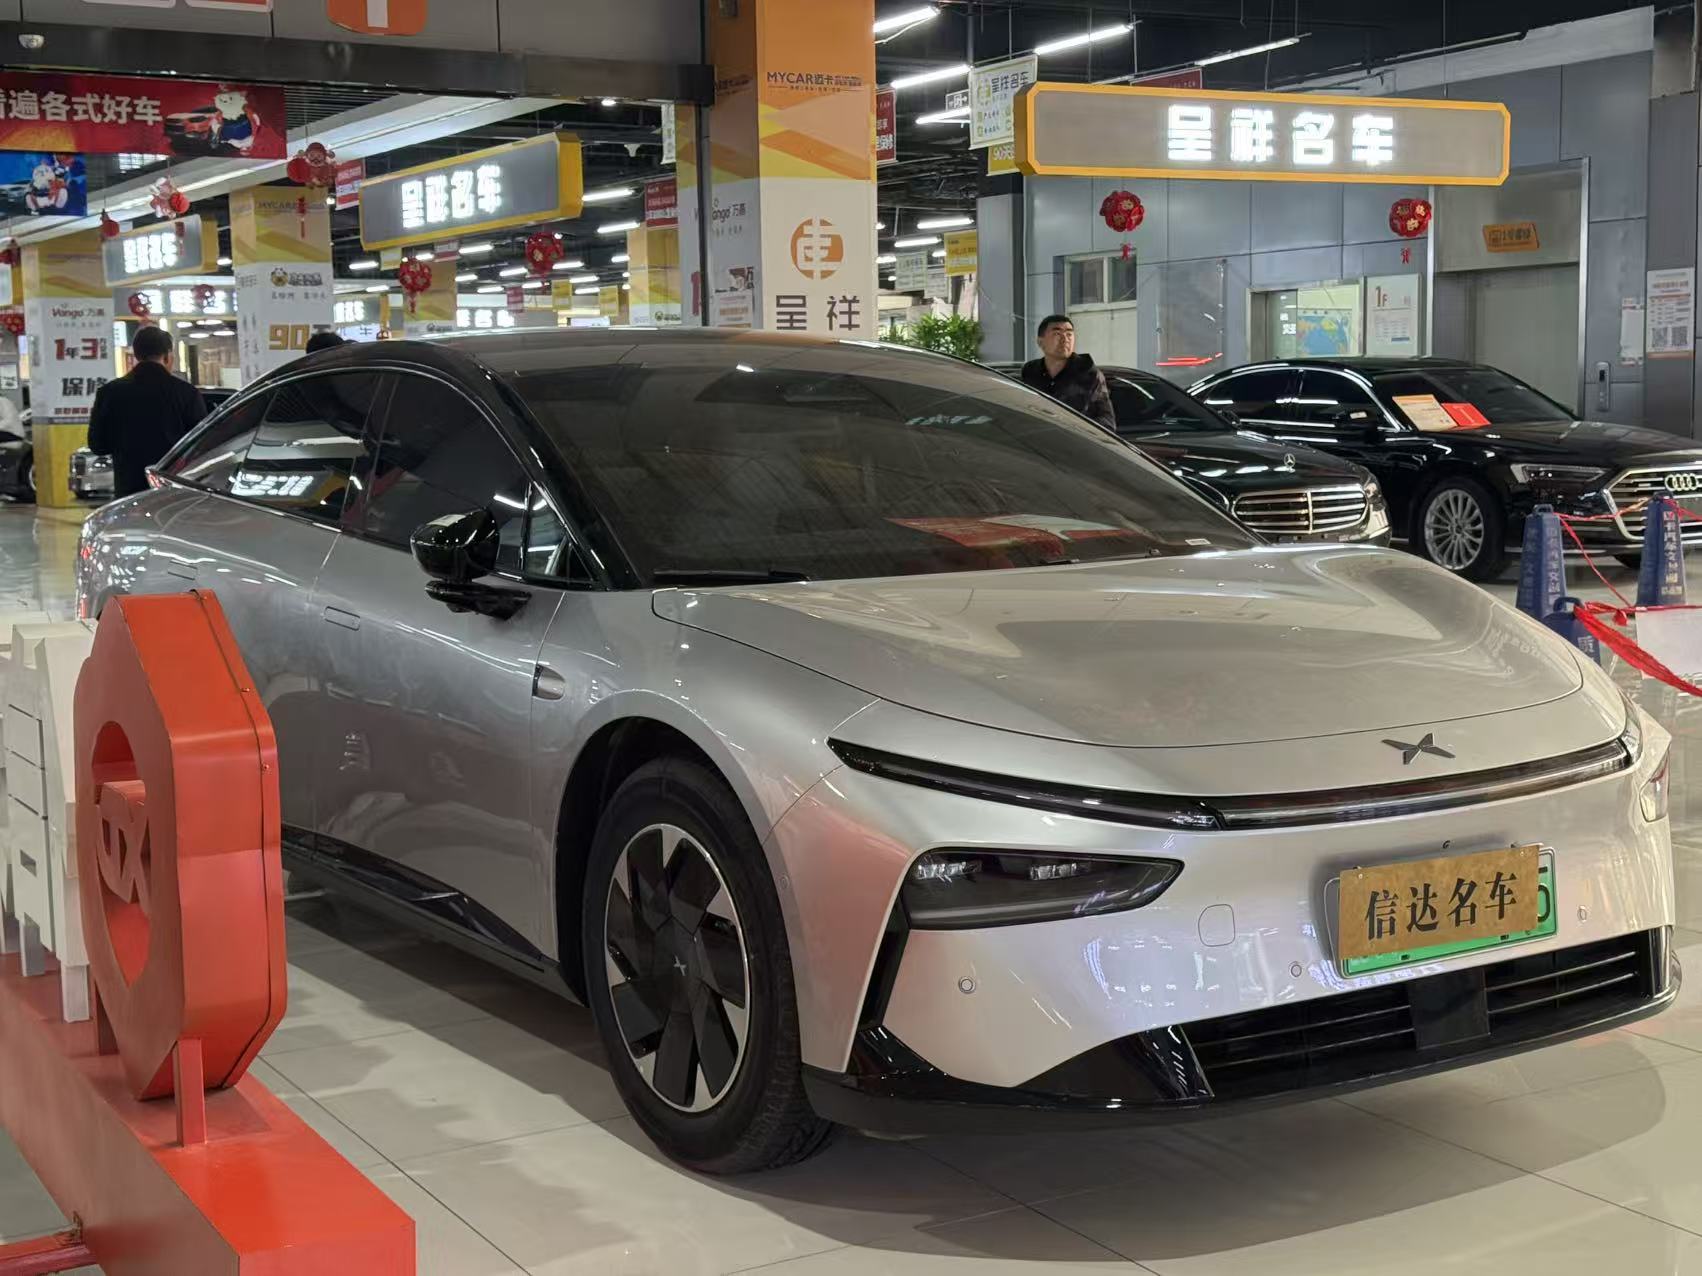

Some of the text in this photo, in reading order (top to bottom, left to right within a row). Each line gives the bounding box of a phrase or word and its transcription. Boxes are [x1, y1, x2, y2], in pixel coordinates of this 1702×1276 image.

[0, 90, 163, 126] 遍各式好车
[1167, 104, 1394, 166] 呈祥名车
[401, 164, 502, 228] 呈祥名车
[776, 295, 860, 331] 呈祥
[1364, 871, 1518, 941] 信达名车
